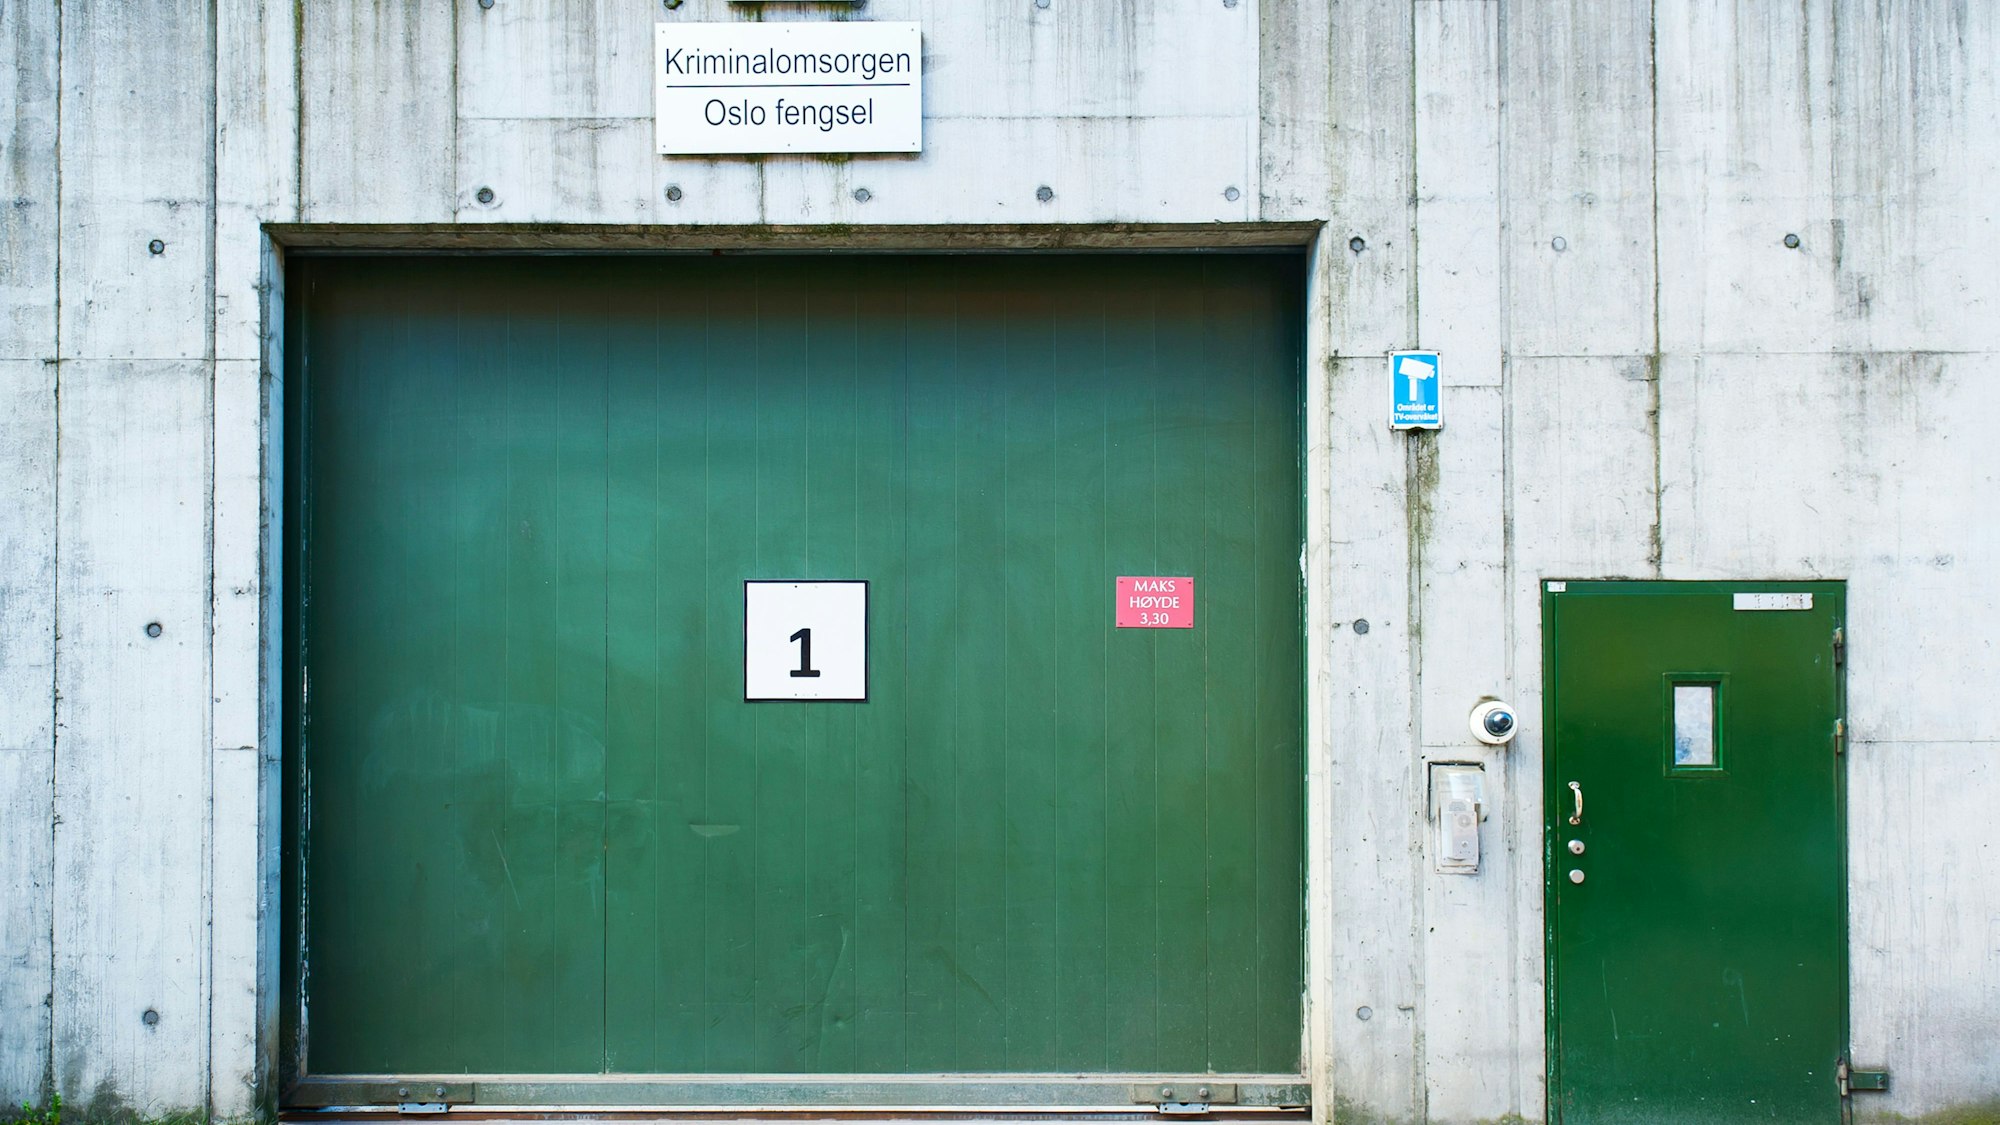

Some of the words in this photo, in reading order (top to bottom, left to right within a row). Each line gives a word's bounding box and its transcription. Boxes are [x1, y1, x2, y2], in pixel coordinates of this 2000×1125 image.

[665, 47, 911, 81] Kriminalomsorgen
[704, 98, 766, 126] Oslo
[776, 98, 873, 132] fengsel
[1427, 404, 1435, 412] er
[1134, 580, 1176, 592] MAKS
[1129, 596, 1180, 609] HØYDE
[1140, 612, 1169, 626] 3,30
[789, 627, 821, 678] 1
